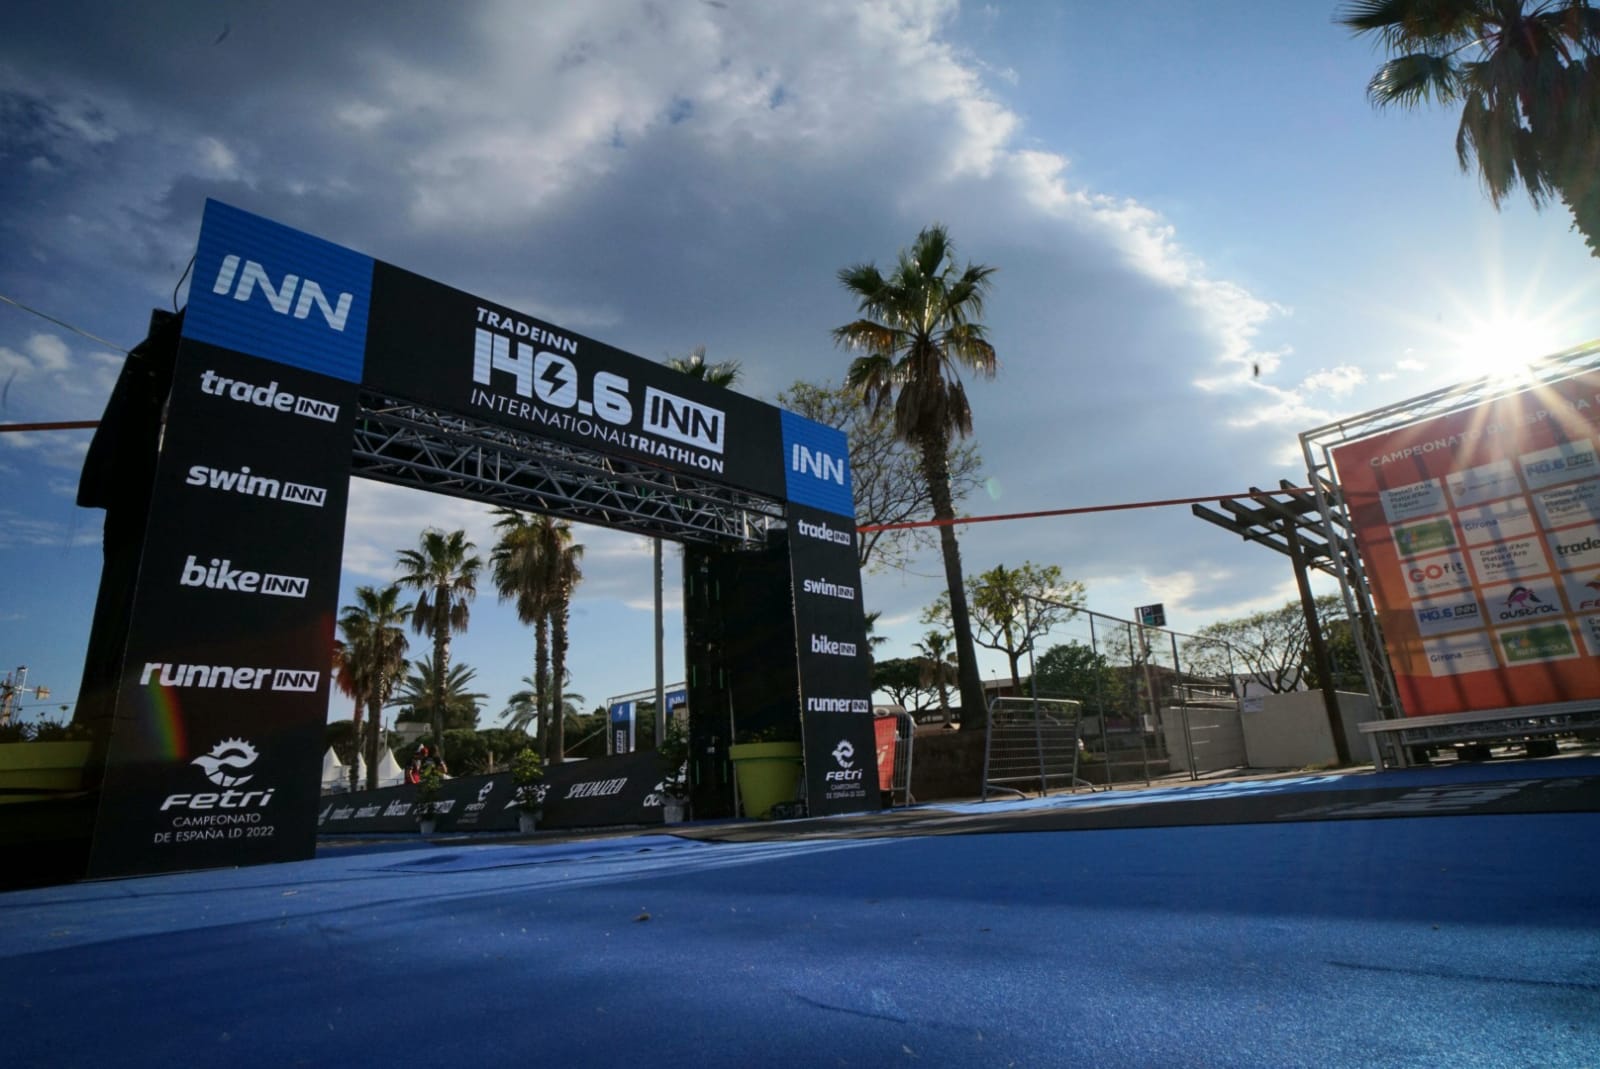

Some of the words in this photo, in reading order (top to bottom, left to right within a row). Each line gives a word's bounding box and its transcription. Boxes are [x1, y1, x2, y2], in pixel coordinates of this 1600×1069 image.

[213, 254, 353, 332] INN
[476, 306, 578, 355] TRADEINN
[473, 327, 633, 426] 140.6
[642, 385, 726, 455] INN
[792, 443, 844, 485] INN
[154, 832, 172, 844] DE
[176, 828, 226, 843] ESPAÑA
[228, 828, 244, 839] LD
[246, 826, 275, 838] 2022
[172, 812, 261, 828] CAMPEONATO
